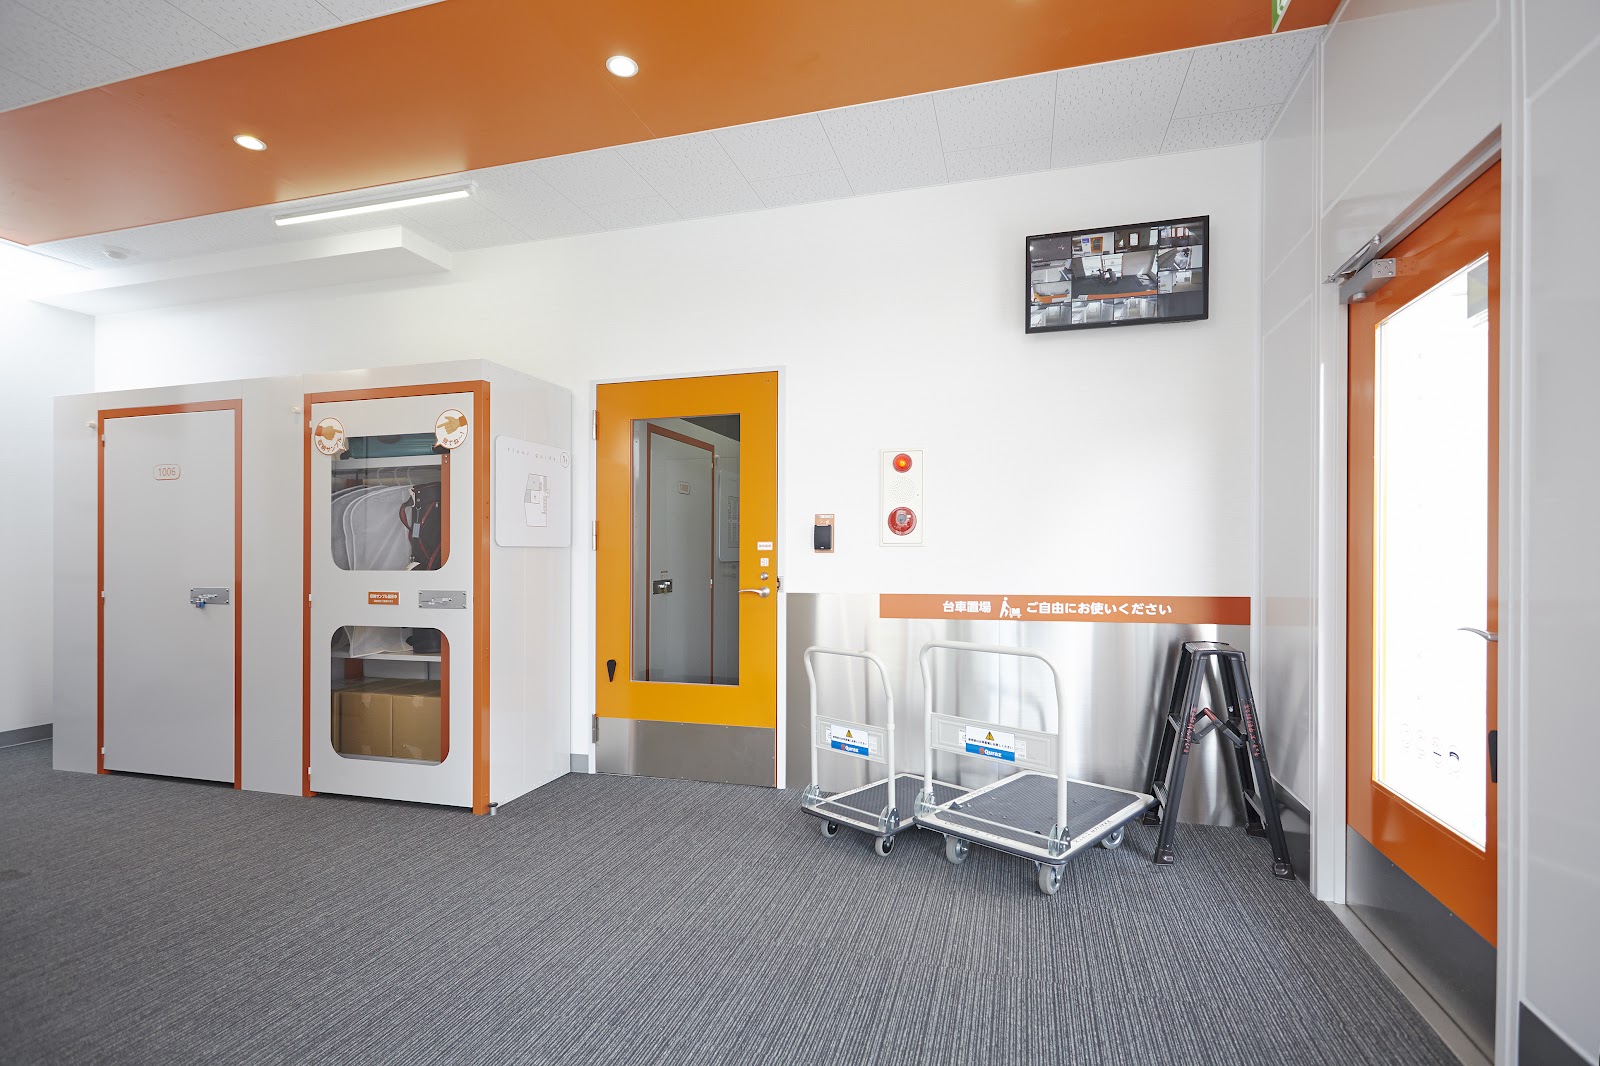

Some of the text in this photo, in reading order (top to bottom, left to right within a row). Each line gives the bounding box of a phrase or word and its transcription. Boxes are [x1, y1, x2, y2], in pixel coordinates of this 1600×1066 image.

[158, 467, 176, 476] 1006
[942, 600, 1172, 616] 台車置場 ご自由にお使いください
